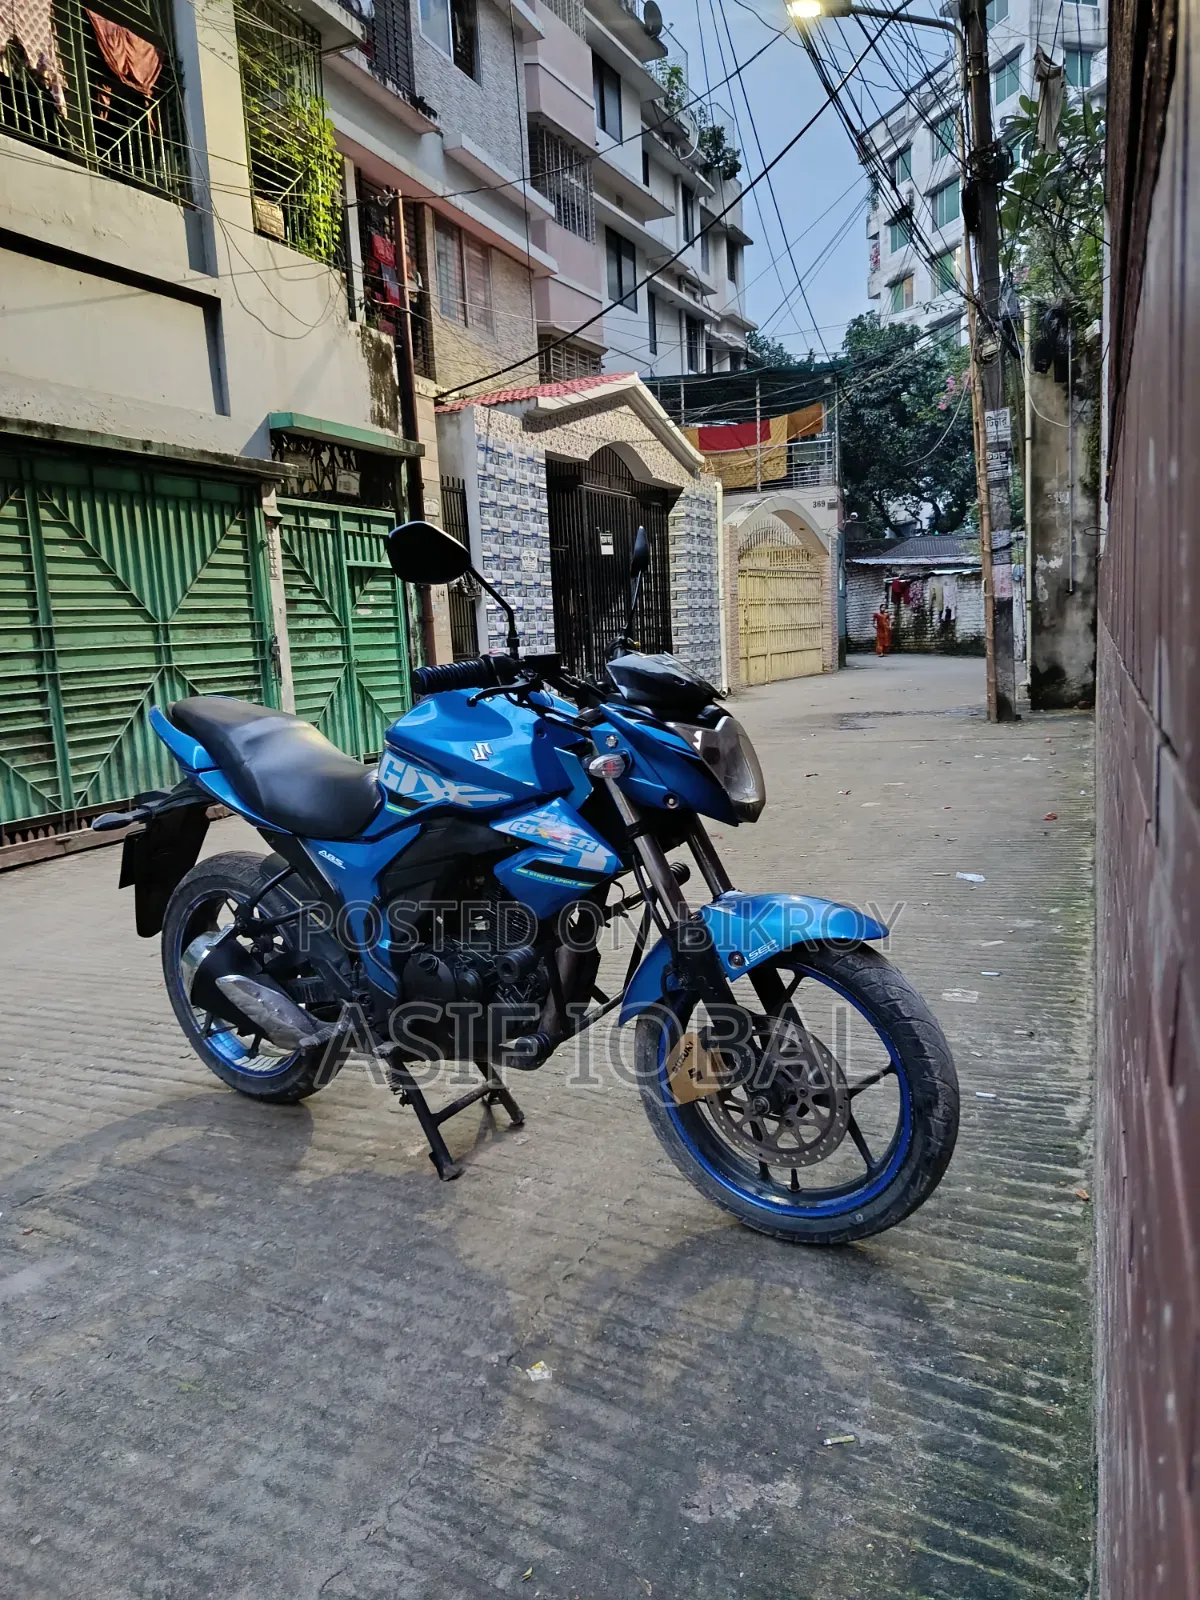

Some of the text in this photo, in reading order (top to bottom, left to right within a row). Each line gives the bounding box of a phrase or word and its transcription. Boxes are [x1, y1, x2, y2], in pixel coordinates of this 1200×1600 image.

[812, 500, 826, 509] 369
[318, 850, 345, 866] ABS
[529, 870, 577, 886] STREET SPORT
[671, 1041, 694, 1073] SUZUKI
